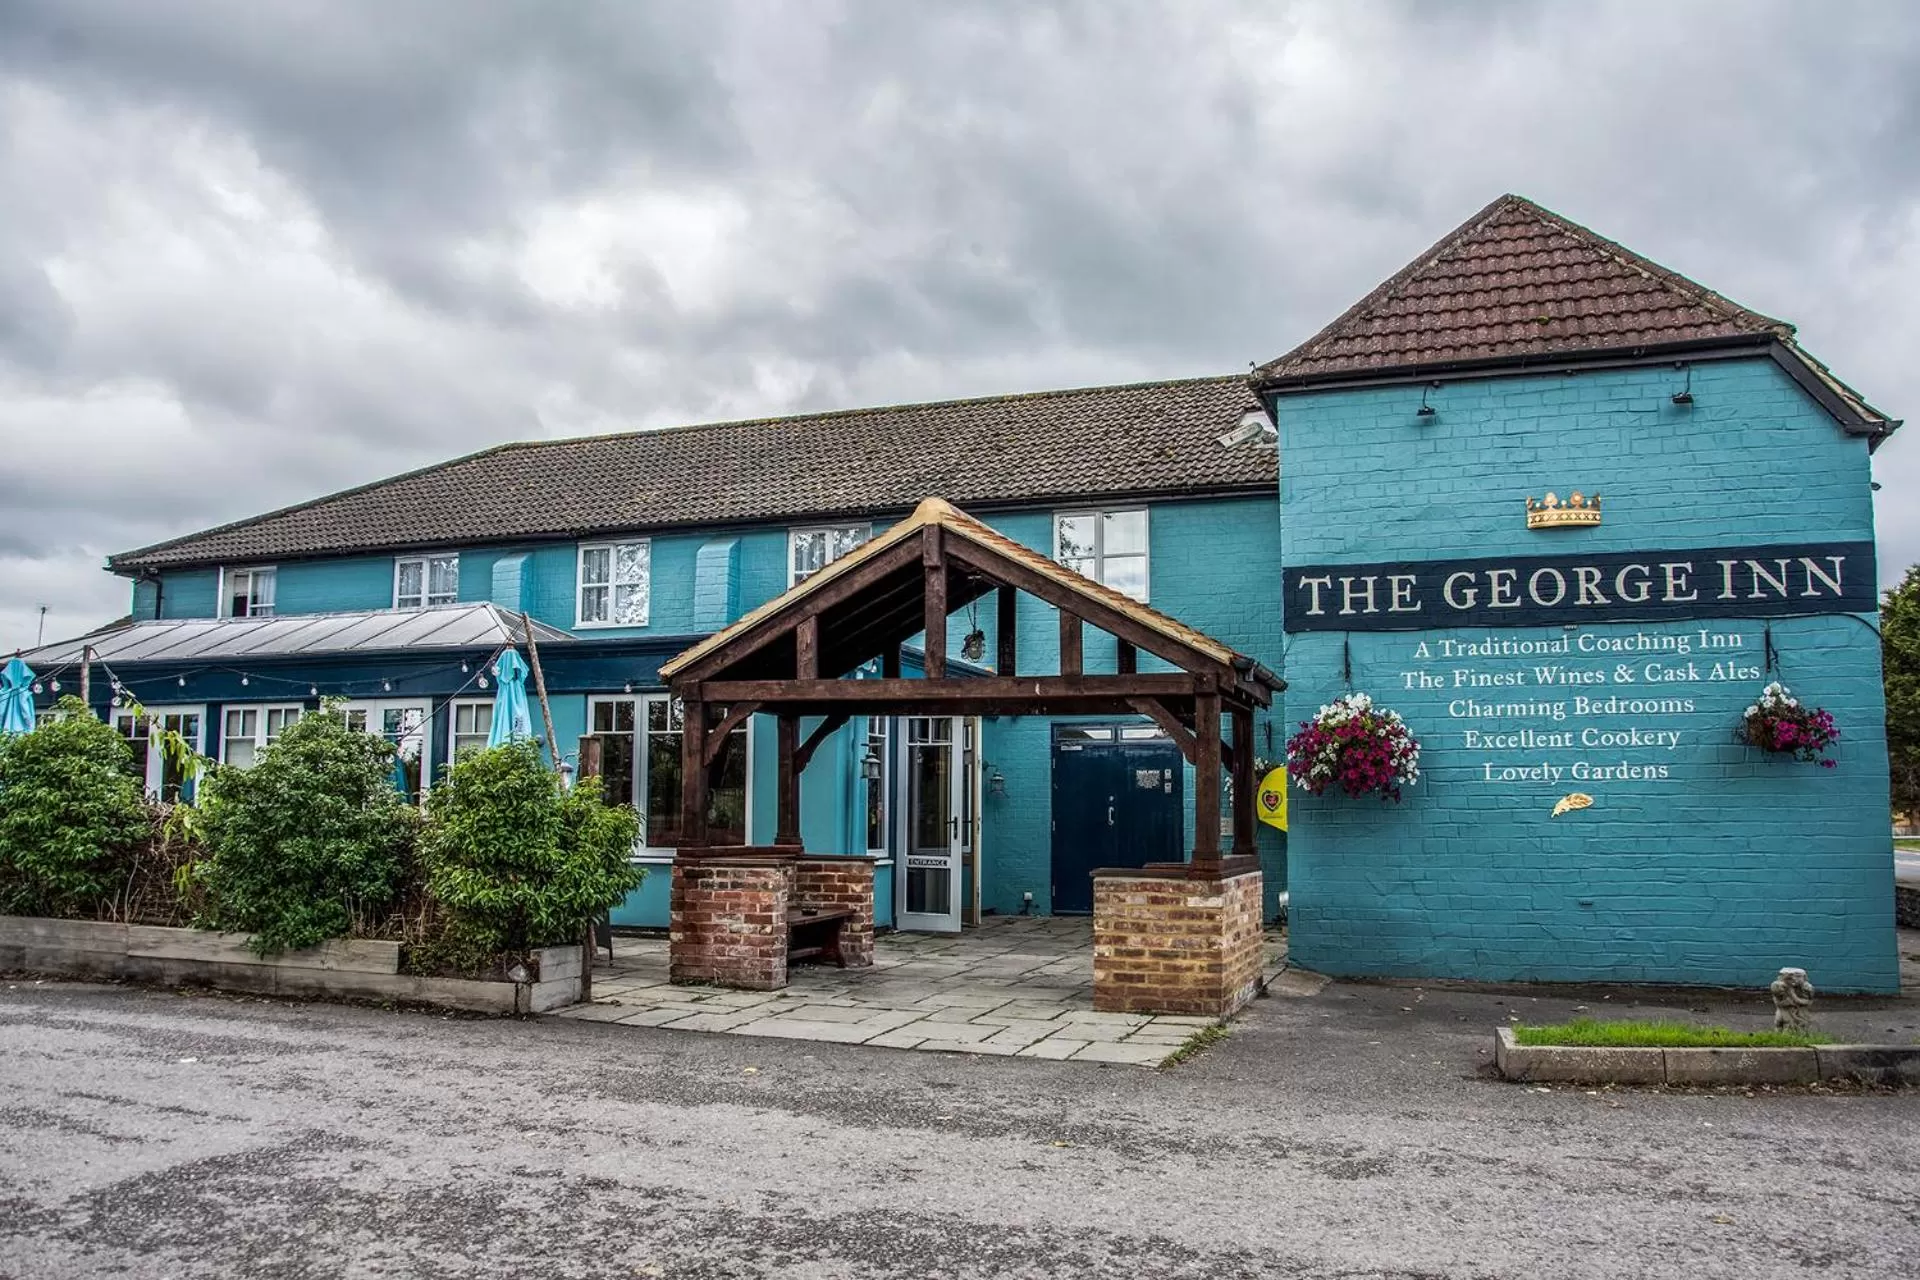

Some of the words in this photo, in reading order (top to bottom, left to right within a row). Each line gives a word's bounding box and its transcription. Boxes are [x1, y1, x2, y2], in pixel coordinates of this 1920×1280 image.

[1300, 575, 1421, 615] THE
[1443, 562, 1698, 609] GEORGE
[1717, 556, 1846, 600] INN
[1415, 643, 1431, 658] A
[1439, 636, 1569, 657] Traditional
[1578, 632, 1691, 653] Coaching
[1699, 630, 1743, 648] Inn
[1401, 671, 1445, 689] The
[1454, 668, 1525, 687] Finest
[1534, 665, 1605, 685] Wines
[1614, 664, 1636, 683] &
[1645, 662, 1701, 682] Cask
[1708, 661, 1761, 680] Ales
[1449, 699, 1566, 721] Charming
[1573, 696, 1695, 715] Bedrooms
[1464, 729, 1573, 749] Excellent
[1581, 728, 1681, 750] Cookery
[1482, 762, 1563, 785] Lovely
[1572, 761, 1669, 780] Gardens
